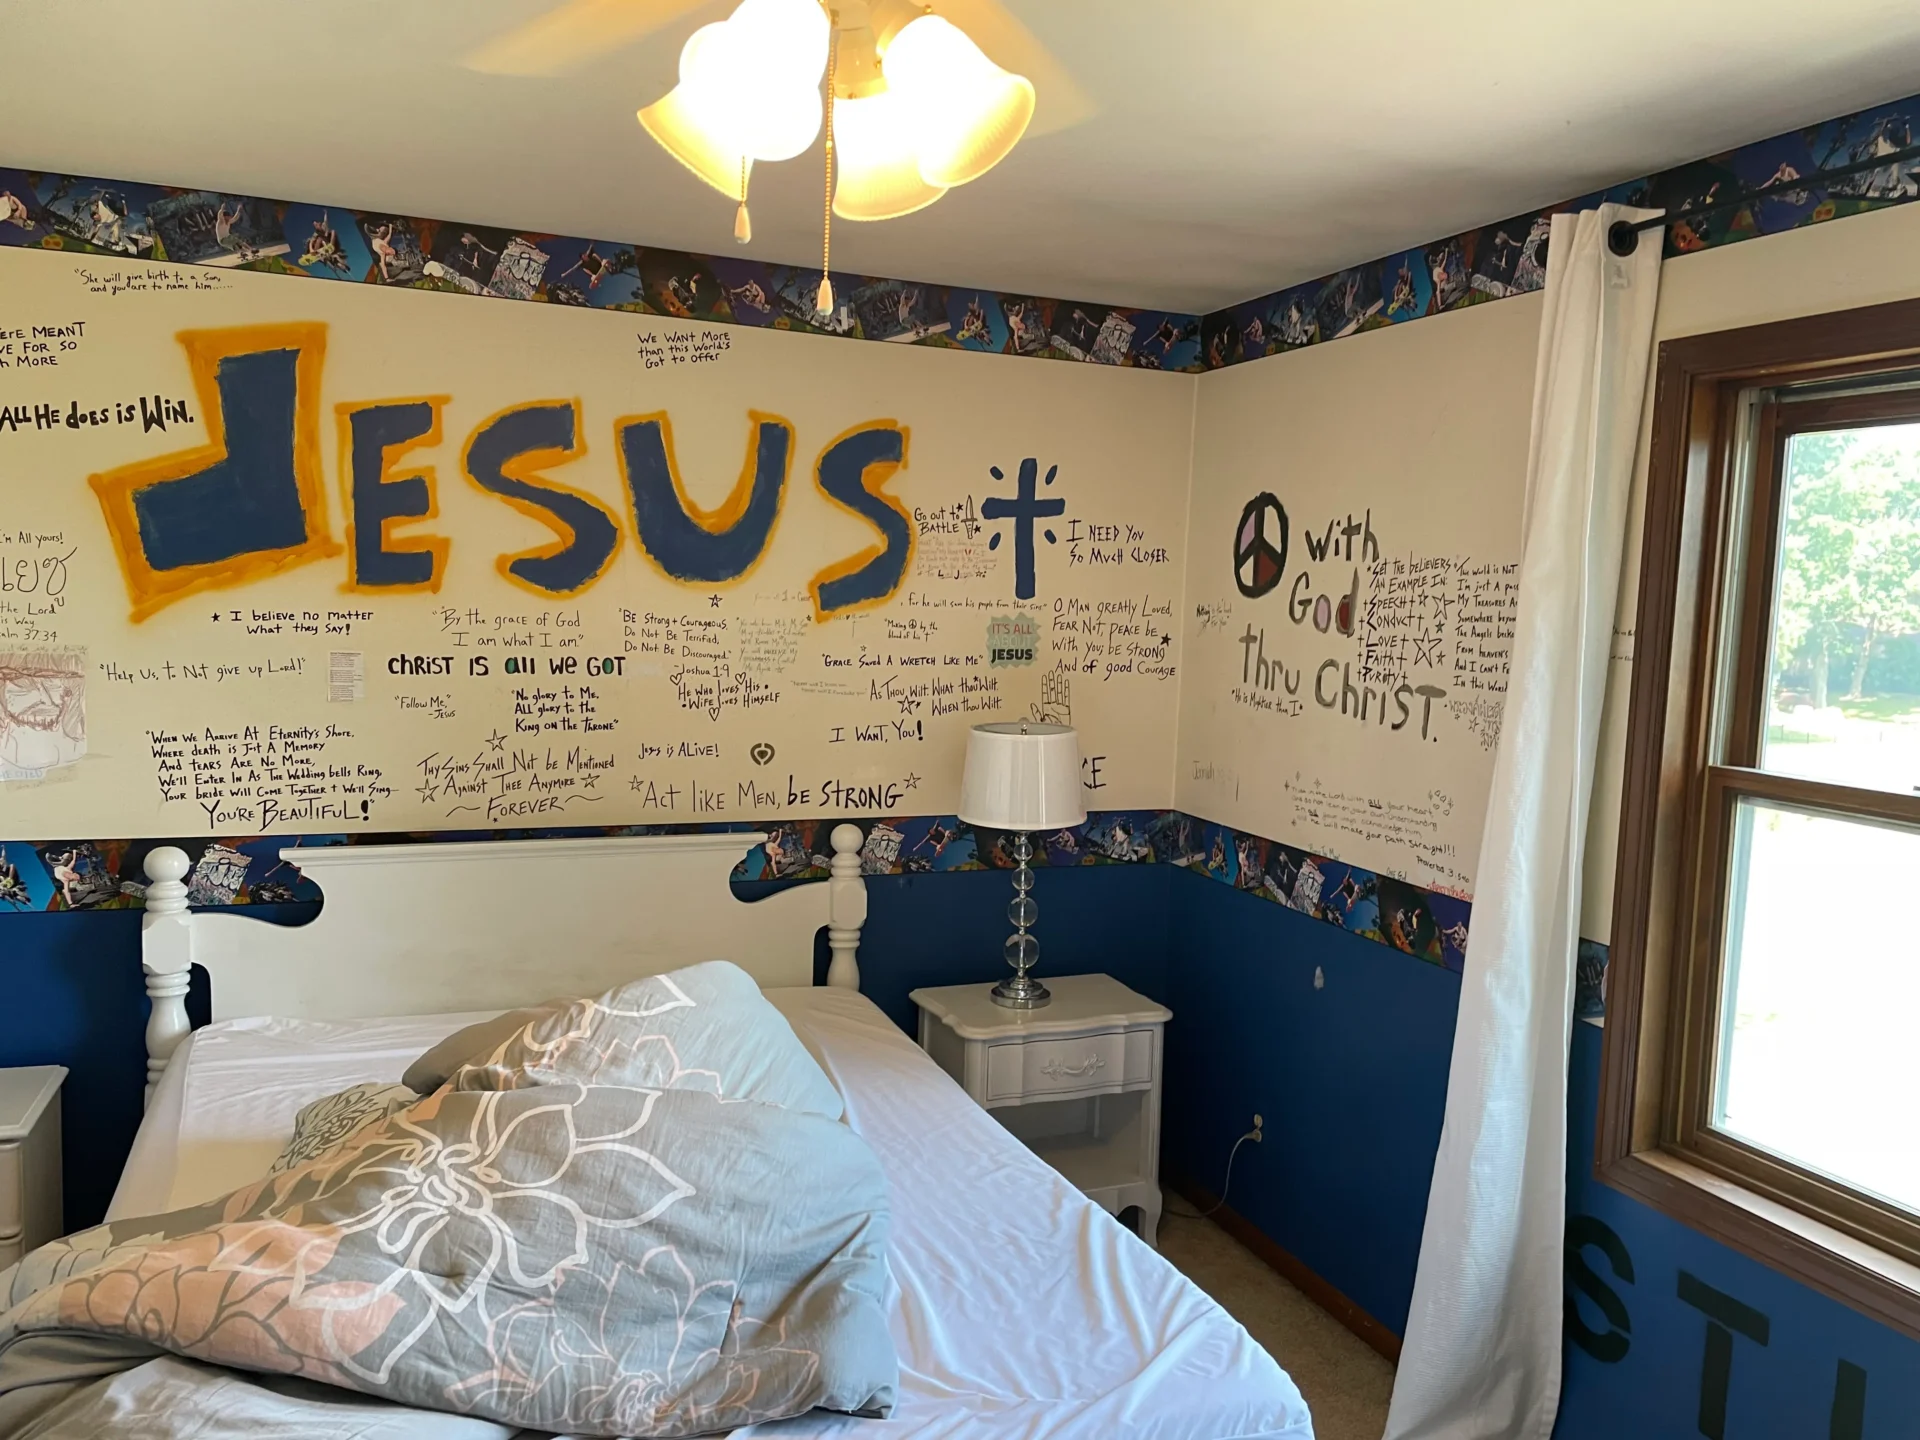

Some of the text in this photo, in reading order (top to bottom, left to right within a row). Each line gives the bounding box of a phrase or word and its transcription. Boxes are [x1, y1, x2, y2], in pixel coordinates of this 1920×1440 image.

[104, 272, 121, 282] will
[126, 272, 143, 287] give
[148, 271, 170, 281] birth
[175, 271, 182, 281] to
[91, 284, 107, 292] and
[112, 286, 126, 295] you
[153, 282, 162, 290] to
[166, 283, 189, 291] name
[32, 322, 85, 337] MEANT
[637, 332, 657, 344] WE
[24, 342, 49, 353] FOR
[60, 341, 77, 351] SO
[638, 347, 663, 359] than
[668, 345, 688, 353] this
[17, 357, 58, 367] MORE
[646, 354, 685, 369] Got to
[0, 406, 32, 431] ALL
[34, 404, 60, 429] HE
[88, 321, 914, 622] JESUS
[915, 505, 959, 521] Go out to
[1066, 519, 1083, 542] I
[1089, 525, 1119, 542] NEED
[1305, 508, 1379, 562] with
[19, 532, 63, 548] All yours!
[1131, 547, 1169, 566] CLOSER
[1493, 565, 1498, 573] is
[1374, 576, 1427, 594] AN EXAMPLE
[1457, 580, 1470, 591] I'm
[1475, 582, 1491, 592] just
[923, 593, 930, 607] he
[966, 598, 974, 607] his
[1054, 598, 1063, 612] O
[1289, 567, 1359, 638] God
[1368, 595, 1407, 615] SPEECH
[28, 603, 56, 615] Lord
[230, 611, 242, 621] I
[303, 612, 319, 620] no
[15, 617, 35, 628] Way
[466, 609, 580, 627] the of God
[644, 613, 670, 629] Strong
[1052, 614, 1078, 631] FEAR
[247, 626, 282, 634] What
[293, 624, 317, 635] they
[624, 626, 635, 637] Do
[642, 628, 659, 638] Not
[993, 623, 1032, 634] IT'S ALL
[452, 632, 469, 646] I
[478, 638, 496, 646] am
[539, 633, 553, 647] I
[1366, 629, 1397, 647] LOVE
[624, 641, 637, 652] Do
[641, 644, 659, 652] Not
[887, 655, 893, 665] A
[991, 649, 1032, 664] JESUS
[1239, 623, 1300, 695] thru
[163, 661, 175, 679] to
[184, 663, 208, 679] Not
[249, 666, 262, 677] up
[469, 657, 488, 676] IS
[505, 657, 535, 674] all
[550, 657, 577, 674] we
[587, 657, 625, 676] GOT
[1082, 659, 1132, 681] of good
[1470, 662, 1476, 672] I
[1472, 675, 1484, 688] this
[532, 686, 574, 704] glory to
[515, 701, 595, 716] ALL glory to the
[932, 699, 958, 716] WHEN
[560, 718, 577, 730] the
[829, 728, 845, 743] I
[228, 744, 236, 754] is
[267, 743, 275, 753] A
[667, 745, 674, 757] is
[643, 781, 681, 810] Act
[487, 795, 564, 819] FOREVER
